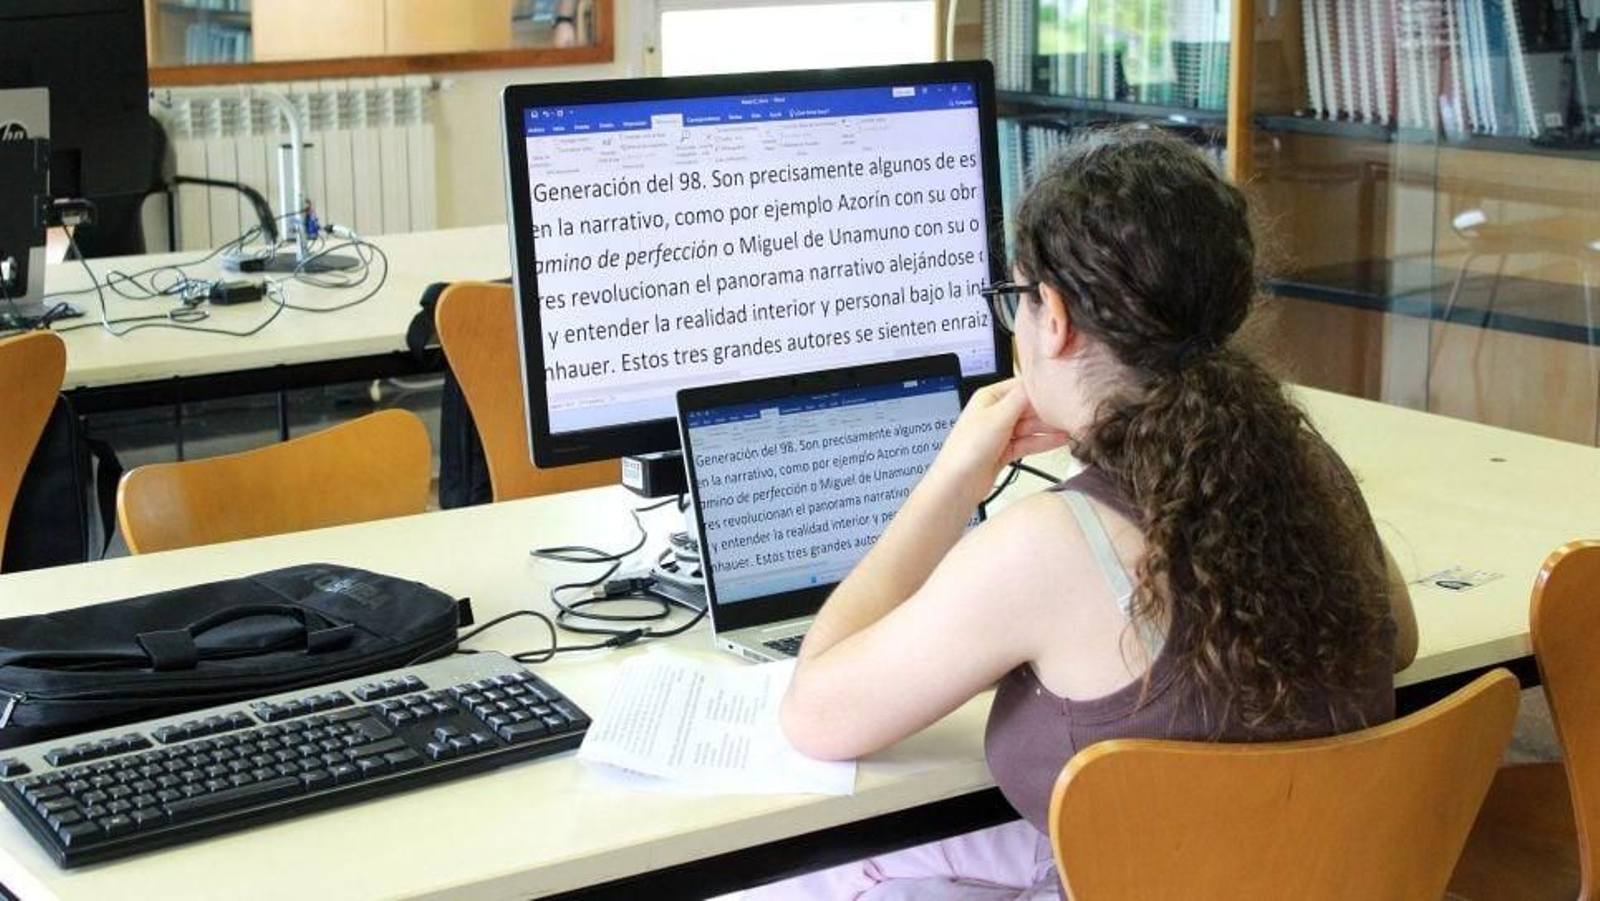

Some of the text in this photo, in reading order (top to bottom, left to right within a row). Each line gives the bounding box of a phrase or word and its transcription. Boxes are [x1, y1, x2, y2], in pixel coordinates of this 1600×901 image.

[534, 152, 977, 203] Generación del 98. Son precisamente algunos de es
[532, 183, 978, 239] en la narrativo, como por ejemplo Azorín con su obr
[597, 248, 620, 268] de
[625, 241, 718, 271] perfección
[723, 242, 735, 256] o
[739, 231, 798, 257] Miguel
[803, 229, 824, 249] de
[829, 223, 910, 246] Unamuno
[914, 221, 943, 237] con
[948, 219, 964, 234] su
[969, 218, 980, 232] o
[571, 280, 690, 307] revolucionan
[696, 274, 711, 293] el
[716, 269, 804, 295] panorama
[809, 257, 885, 281] narrativo
[889, 249, 975, 273] alejándose
[548, 330, 559, 350] y
[565, 317, 650, 344] entender
[655, 313, 670, 332] la
[676, 303, 748, 331] realidad
[752, 300, 816, 321] interior
[820, 301, 830, 318] y
[835, 286, 905, 314] personal
[910, 285, 944, 306] bajo
[948, 281, 962, 298] la
[545, 310, 989, 381] nhauer. Estos tres grandes autores se sienten enraiz
[696, 446, 759, 468] Generación
[761, 443, 778, 458] del
[799, 439, 820, 451] Son
[822, 427, 892, 448] precisamente
[894, 422, 932, 438] algunos
[934, 419, 948, 431] de
[711, 474, 722, 486] la
[724, 467, 778, 485] narrativo,
[779, 461, 810, 476] como
[812, 459, 830, 473] por
[832, 449, 876, 469] ejemplo
[911, 443, 930, 454] con
[723, 505, 793, 528] revolucionan
[795, 502, 806, 515] el
[808, 494, 862, 516] panorama
[863, 486, 910, 502] narrativo
[736, 491, 750, 504] de
[752, 483, 808, 504] perfección
[810, 481, 818, 492] o
[820, 475, 856, 491] Miguel
[858, 472, 872, 483] de
[873, 463, 924, 482] Unamuno
[711, 541, 718, 554] y
[721, 531, 771, 550] entender
[774, 528, 784, 540] la
[786, 517, 829, 540] realidad
[832, 513, 870, 531] interior
[872, 514, 878, 526] y
[756, 551, 785, 566] Estos
[787, 546, 808, 559] tres
[809, 541, 852, 559] grandes
